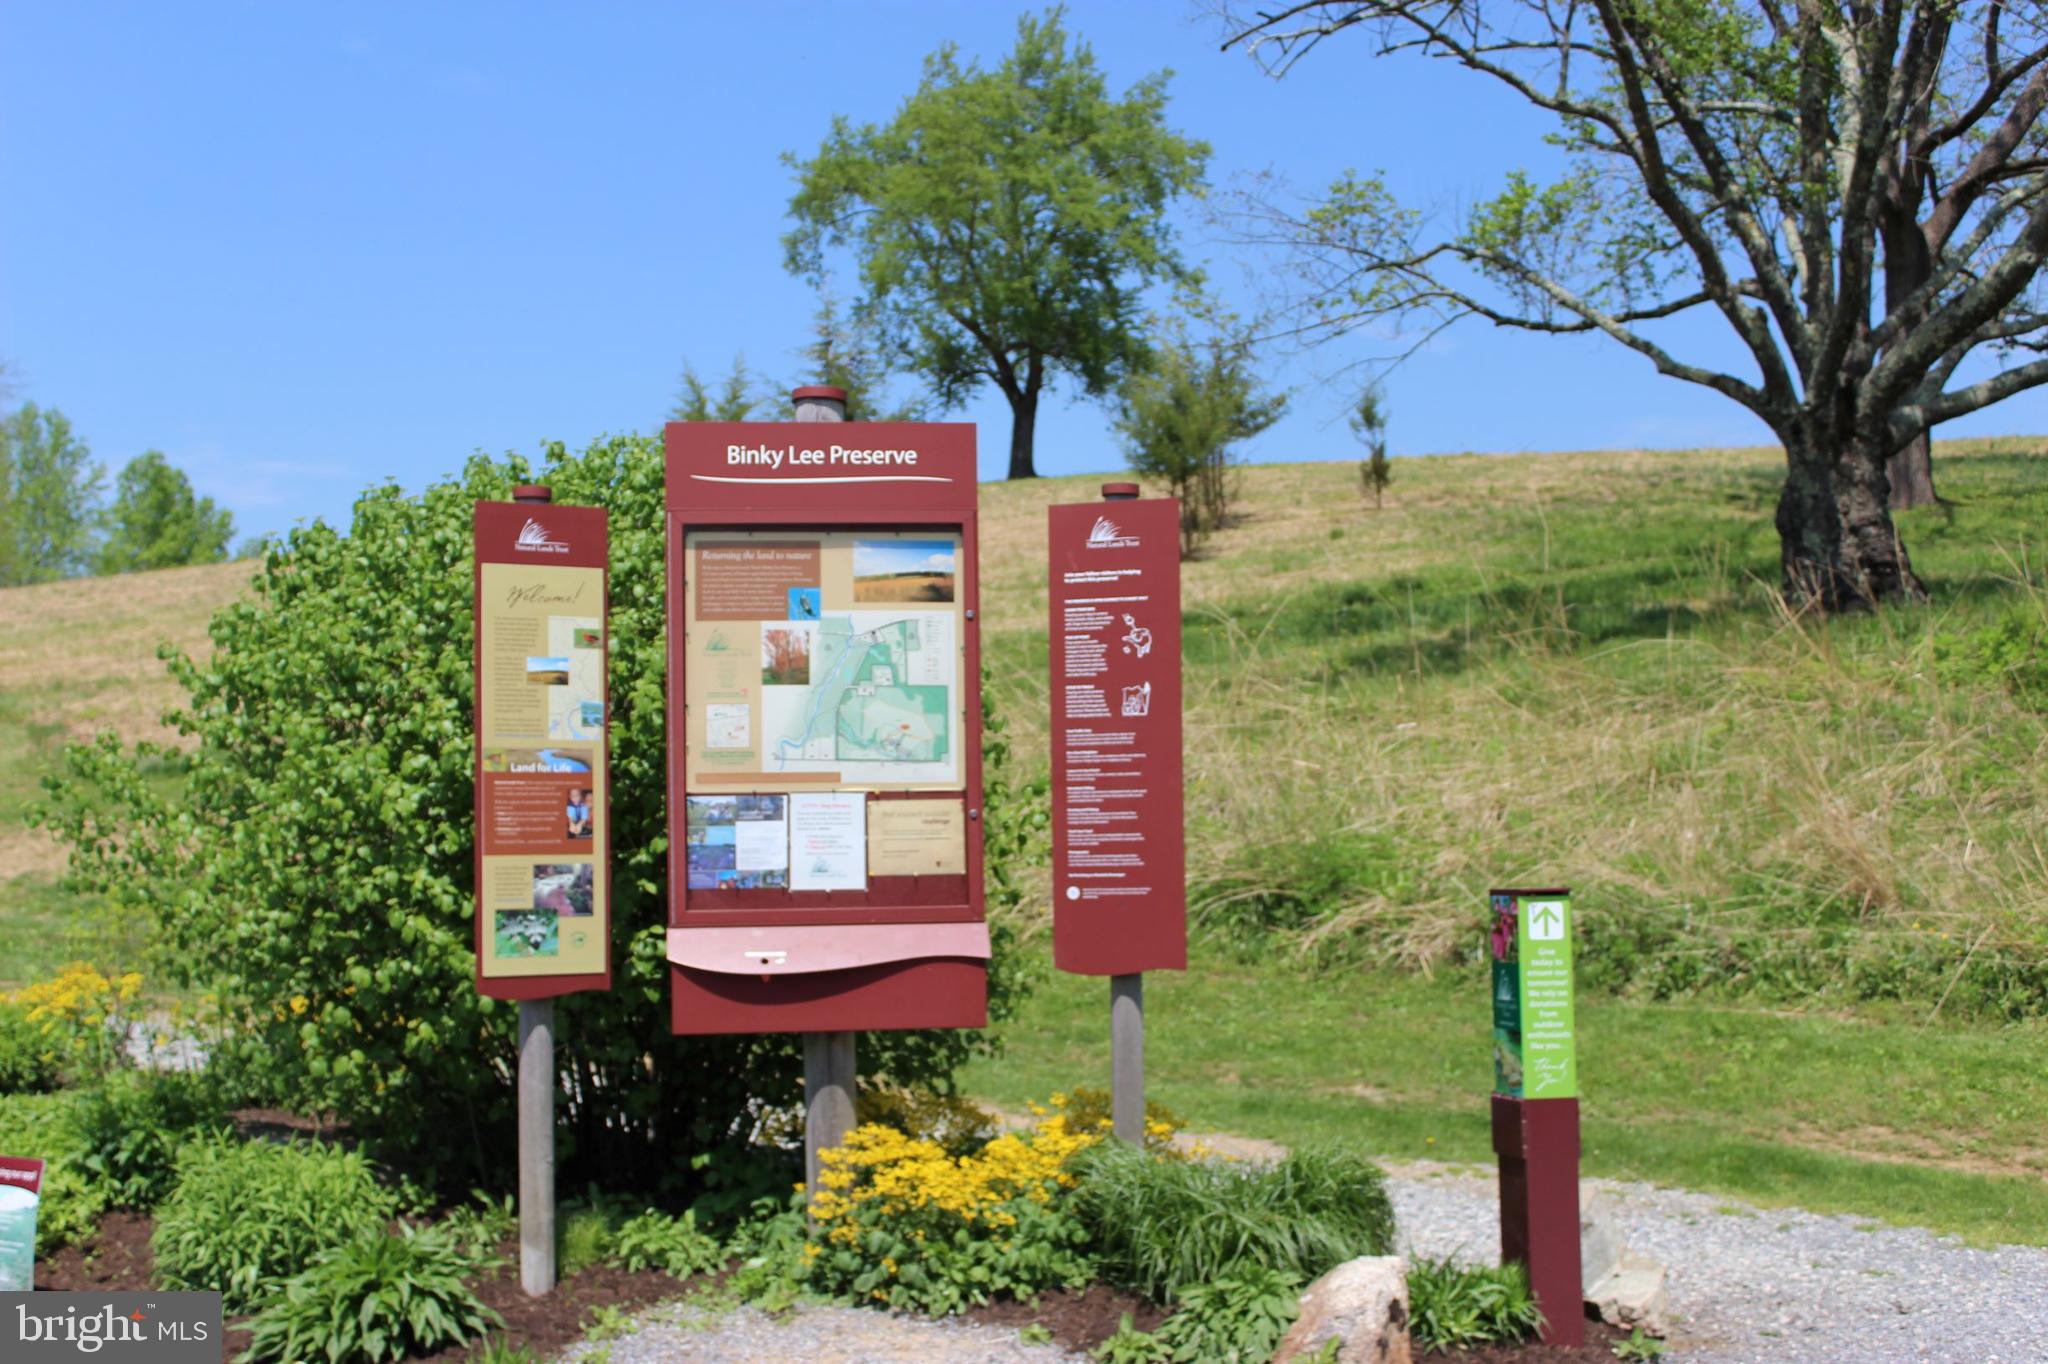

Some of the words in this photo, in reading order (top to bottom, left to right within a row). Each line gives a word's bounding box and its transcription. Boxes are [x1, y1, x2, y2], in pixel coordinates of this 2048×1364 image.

[727, 445, 784, 469] Binky
[789, 445, 825, 465] Lee
[830, 445, 918, 465] Preserve
[510, 762, 536, 773] Land
[537, 762, 551, 773] for
[553, 762, 572, 773] Life
